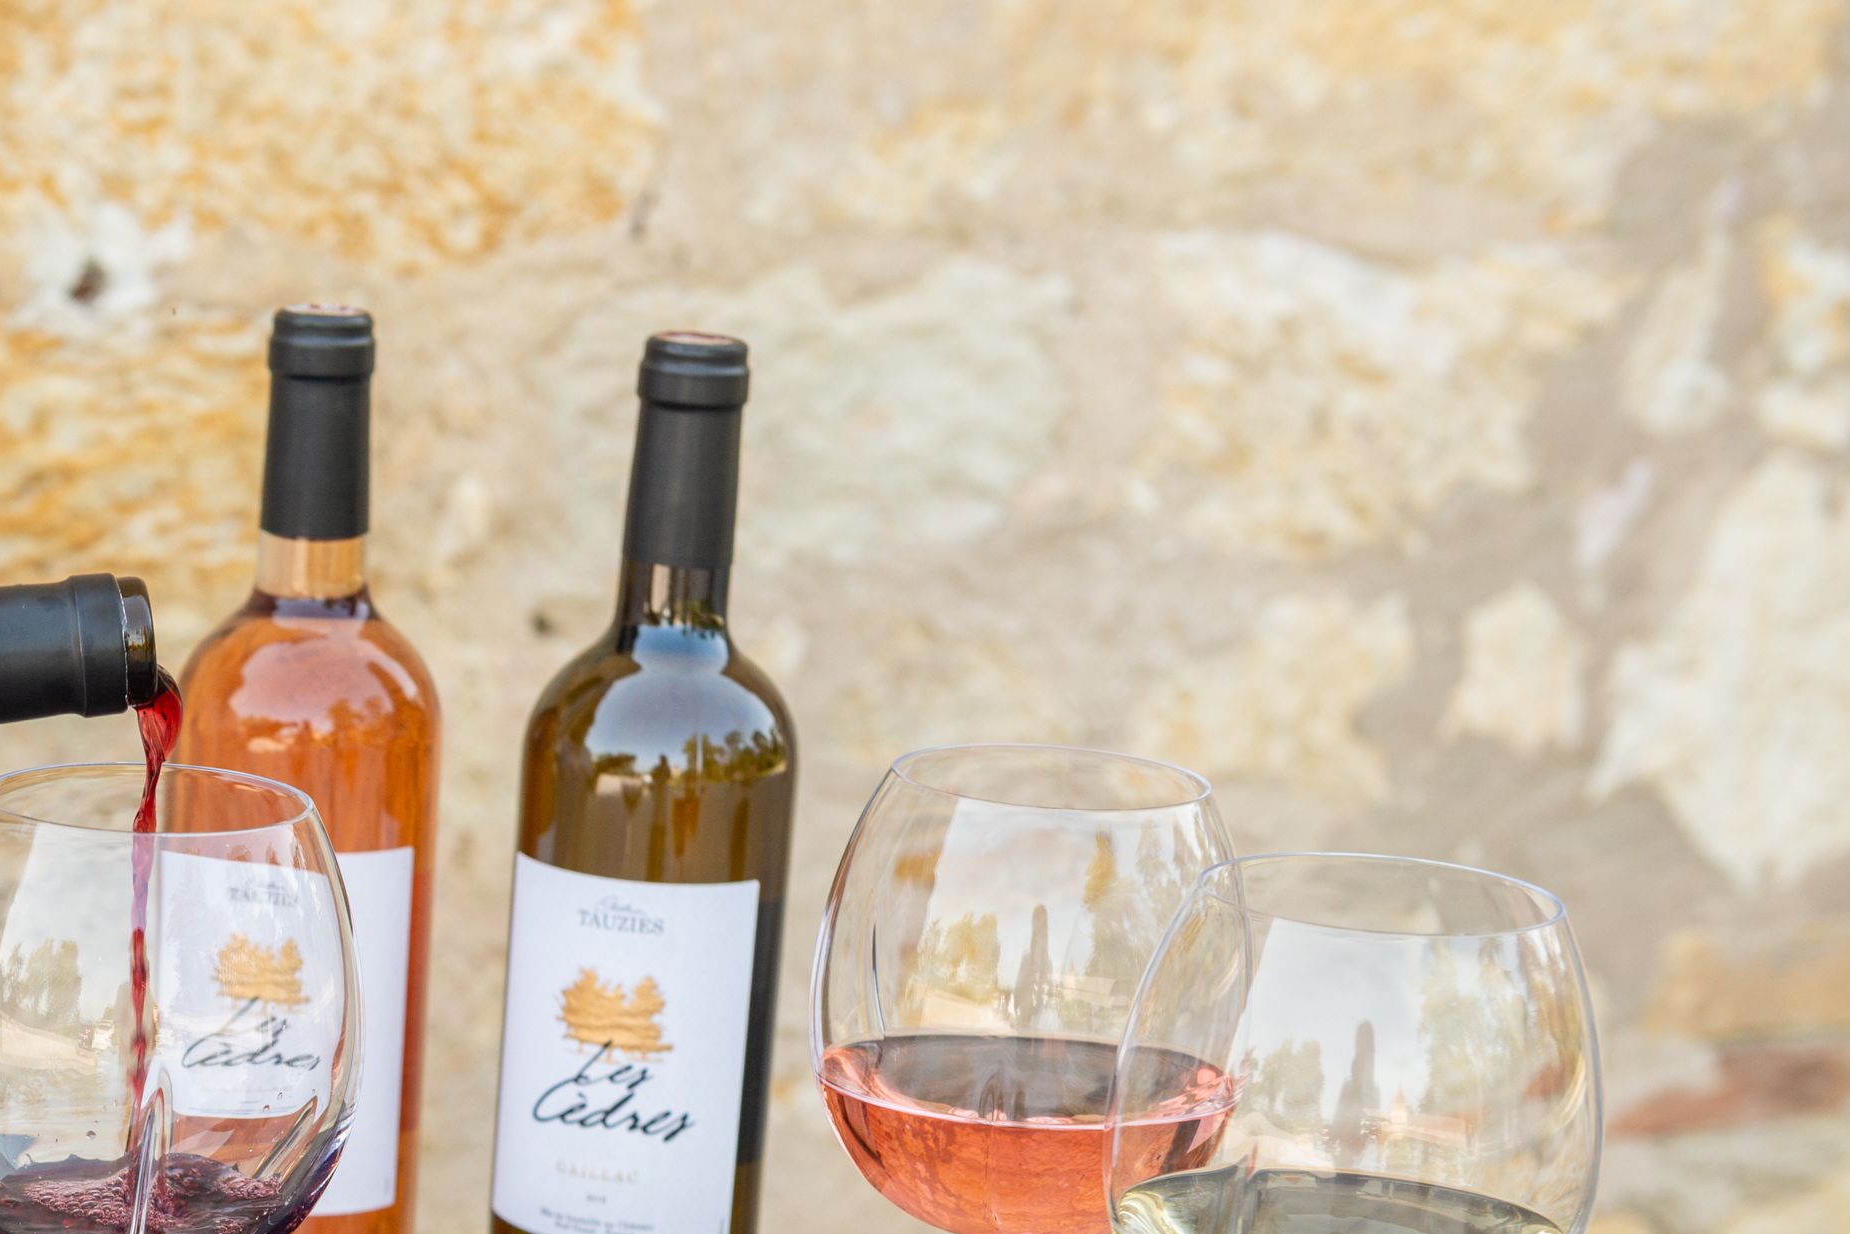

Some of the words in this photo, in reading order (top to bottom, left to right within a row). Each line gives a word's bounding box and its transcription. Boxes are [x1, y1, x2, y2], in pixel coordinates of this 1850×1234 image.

[577, 908, 665, 936] TAUZIES
[574, 1039, 654, 1090] Les
[532, 1076, 696, 1143] Cèdres
